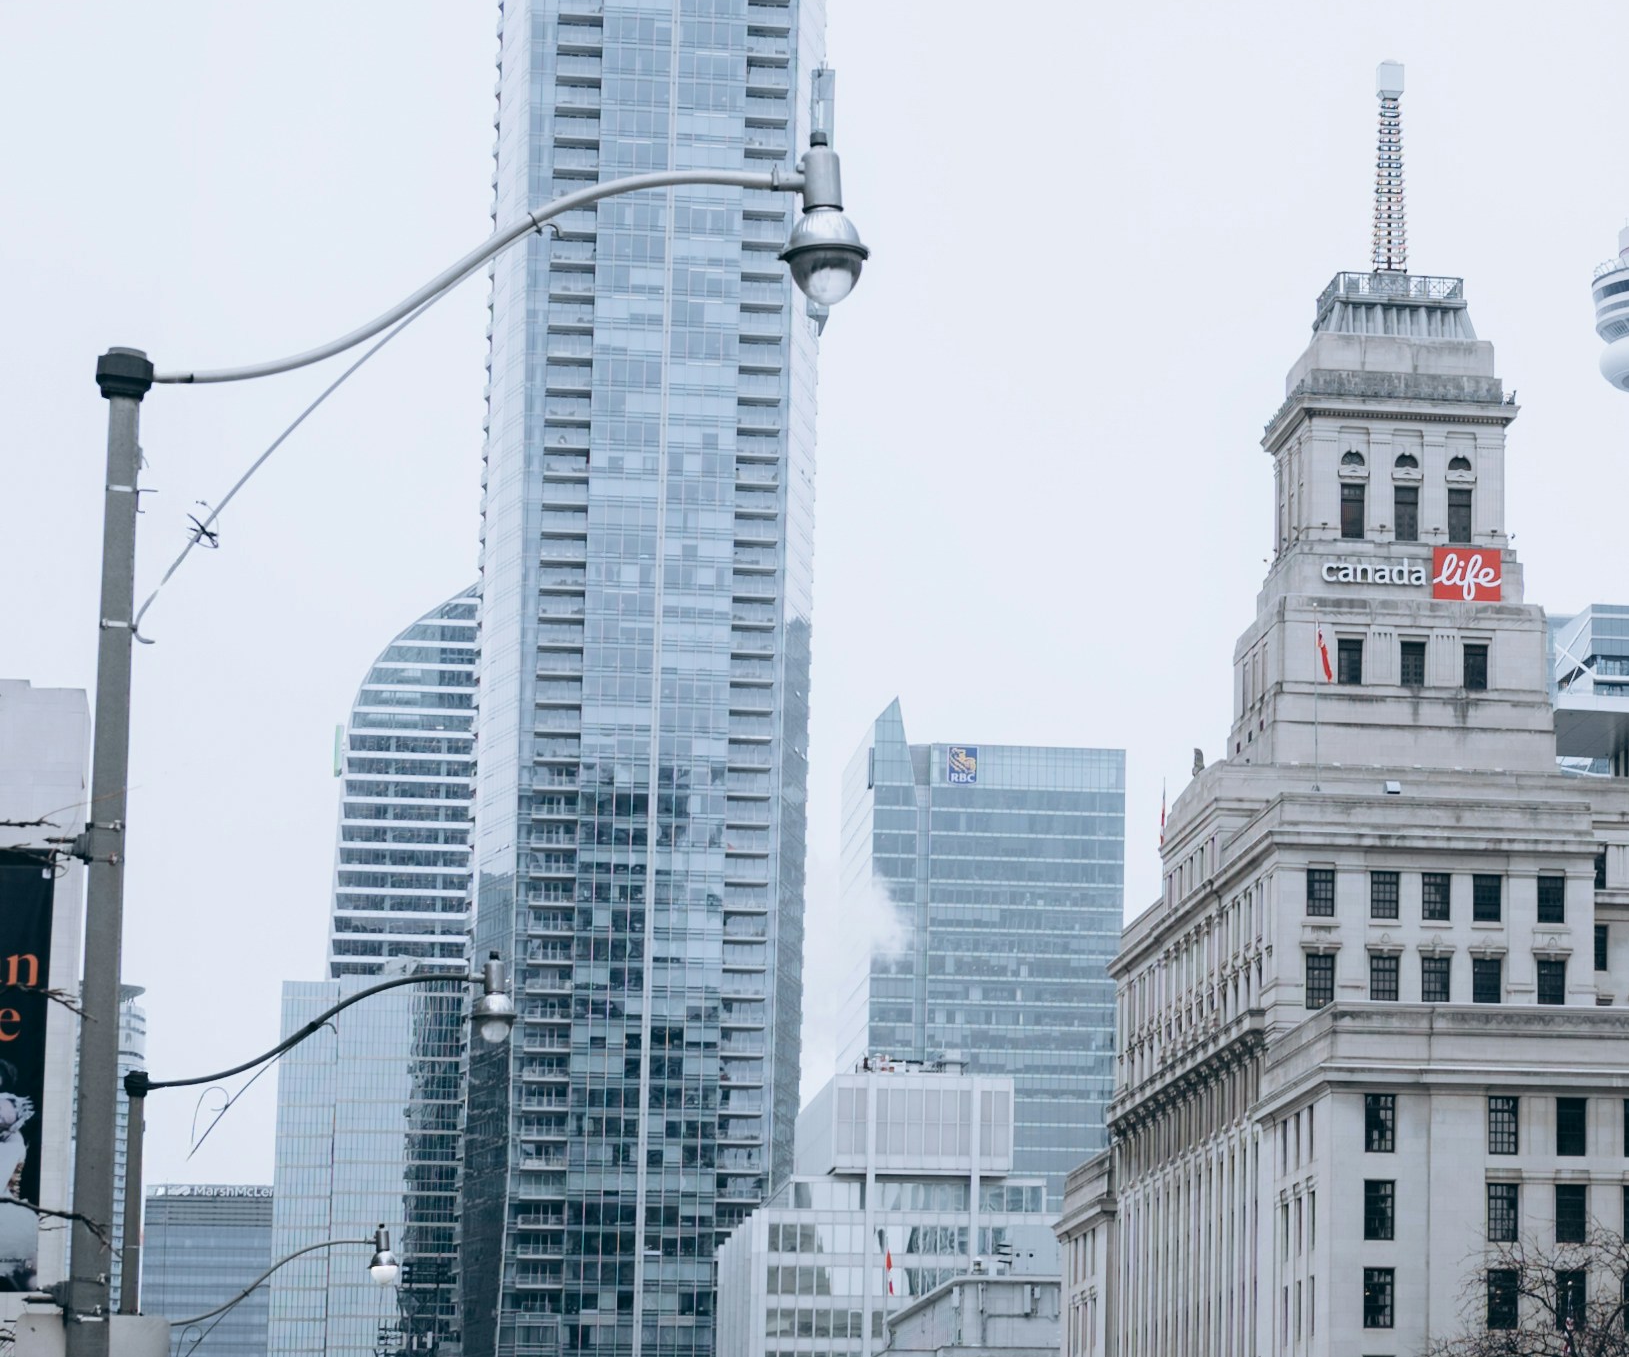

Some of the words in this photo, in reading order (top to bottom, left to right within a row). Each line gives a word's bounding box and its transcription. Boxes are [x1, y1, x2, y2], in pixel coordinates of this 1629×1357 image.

[1321, 558, 1427, 586] canada
[1433, 553, 1501, 601] life
[951, 772, 975, 782] RBC
[0, 953, 39, 986] n
